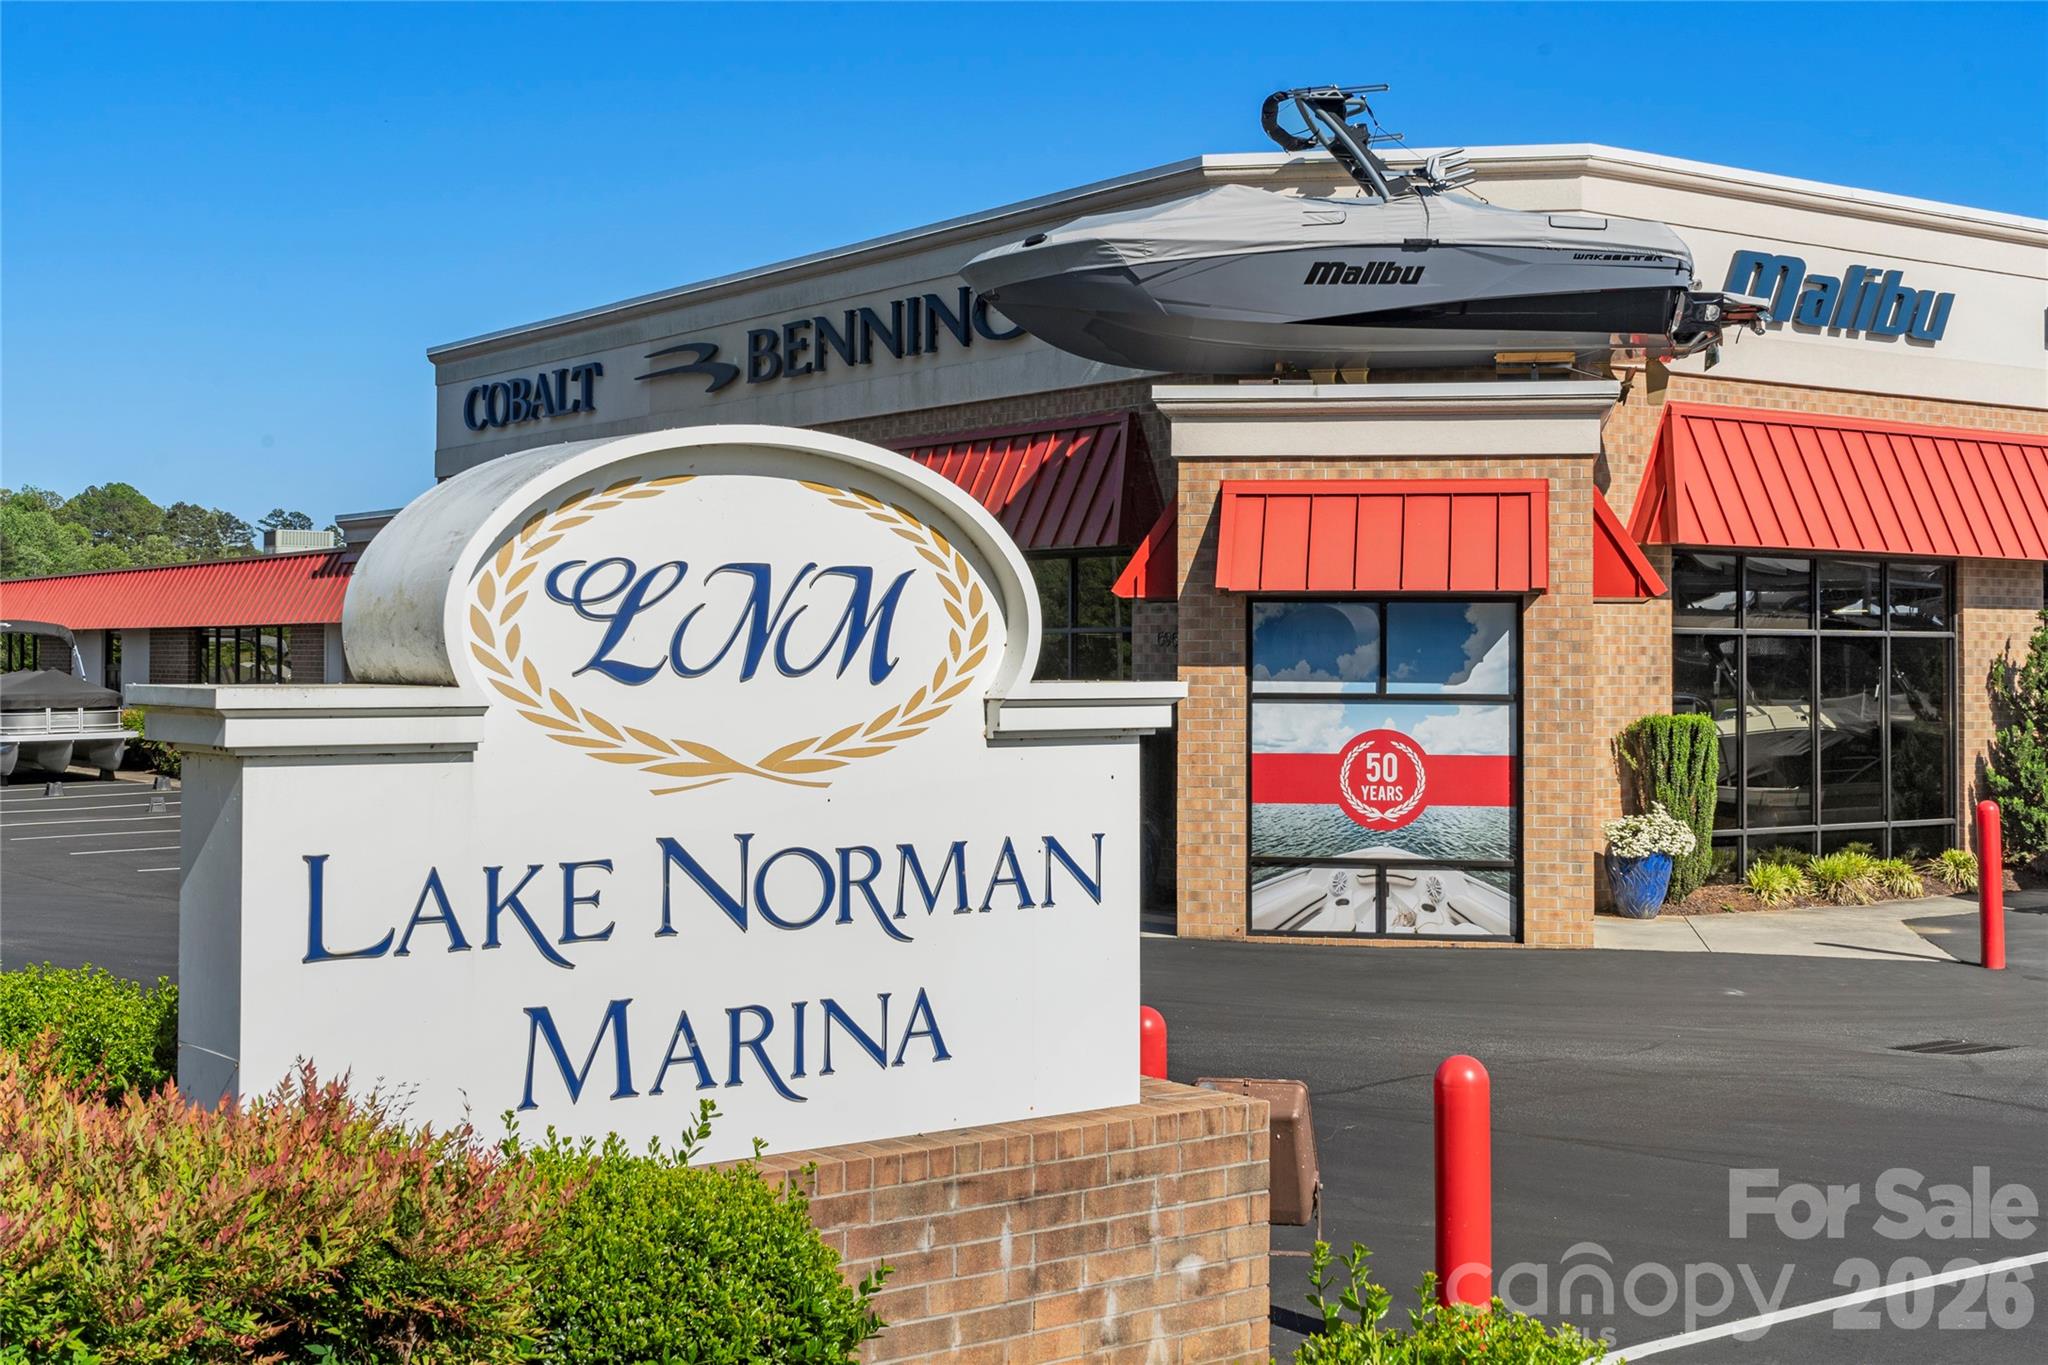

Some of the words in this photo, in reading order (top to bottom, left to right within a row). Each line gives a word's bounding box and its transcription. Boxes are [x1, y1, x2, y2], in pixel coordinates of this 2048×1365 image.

[1303, 261, 1426, 286] Malibu
[1723, 250, 1955, 342] Malibu
[463, 361, 604, 432] COBALT
[545, 556, 917, 686] LNM
[1361, 785, 1404, 801] YEARS
[1366, 752, 1398, 783] 50
[302, 853, 616, 970] LAKE
[654, 832, 1106, 943] NORMAN
[517, 986, 952, 1112] MARINA
